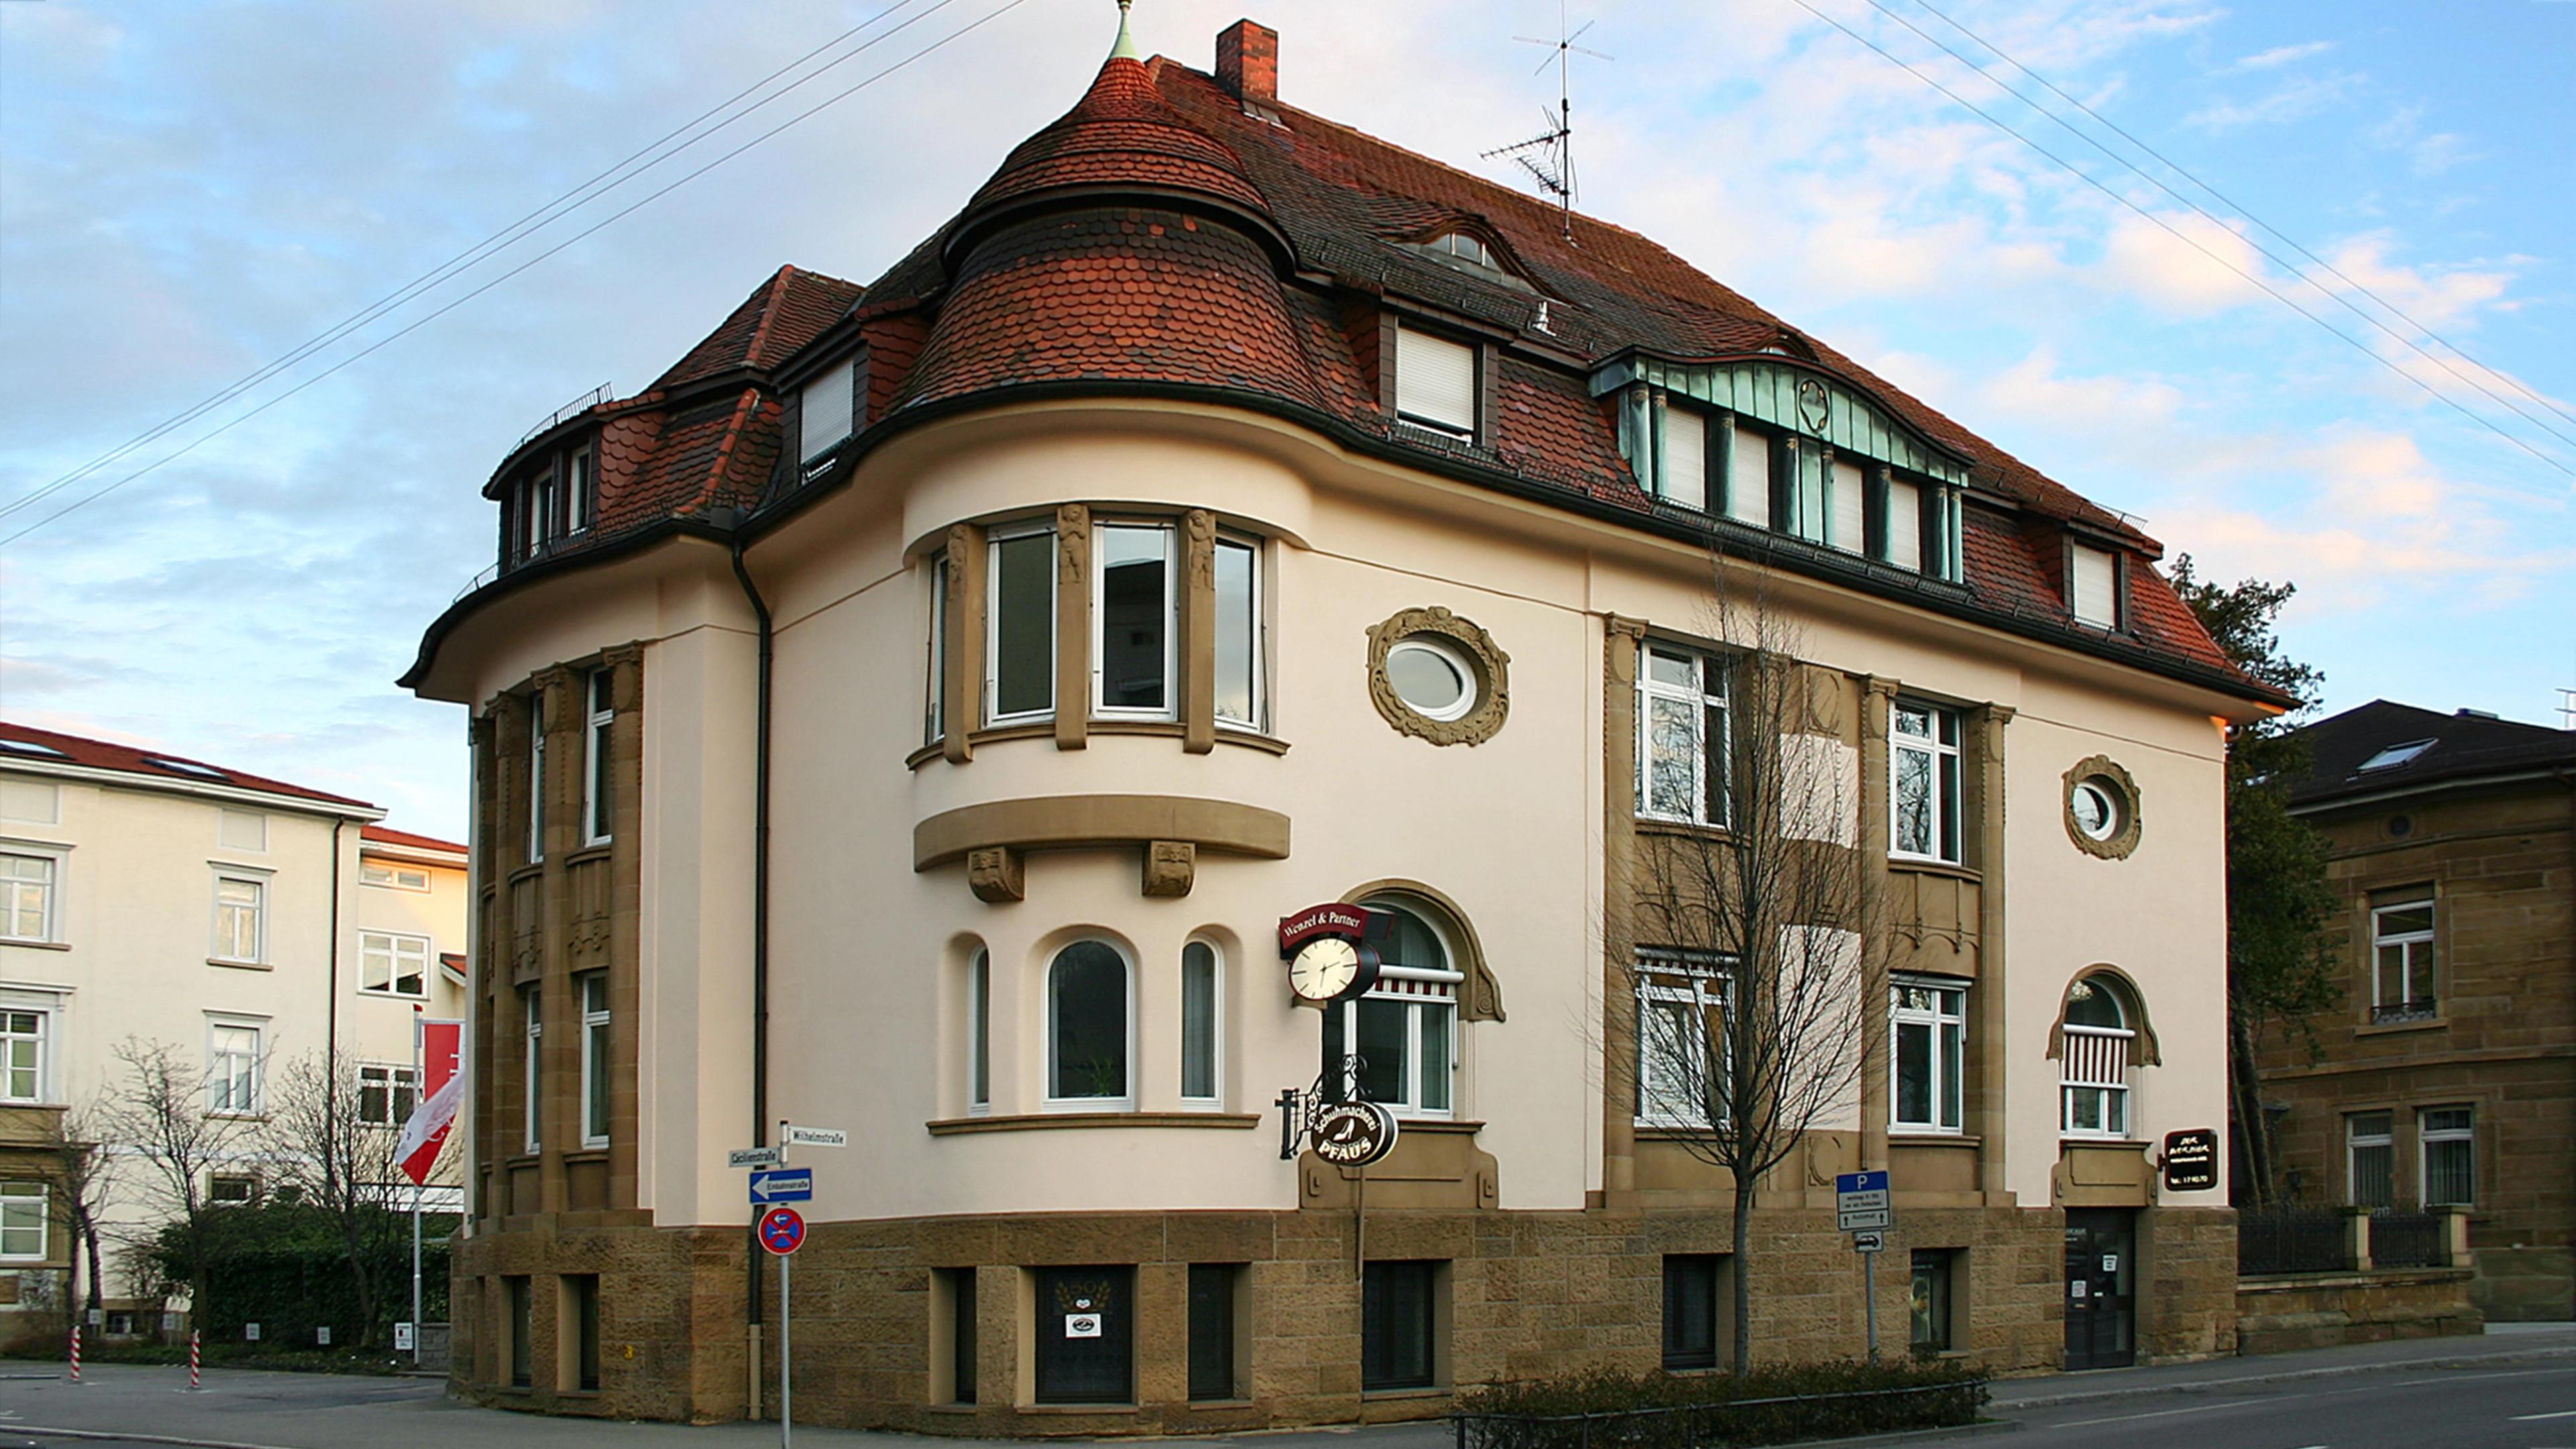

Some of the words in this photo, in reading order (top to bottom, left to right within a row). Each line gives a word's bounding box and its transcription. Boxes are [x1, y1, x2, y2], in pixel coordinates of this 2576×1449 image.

[1284, 914, 1316, 937] Wenzel
[1318, 912, 1328, 925] &
[1329, 911, 1360, 928] Partner
[1314, 1105, 1381, 1134] Schuhmacherei
[794, 1131, 844, 1144] Wilhelmstraße
[767, 1181, 808, 1191] Einbahnstraße
[1857, 1175, 1868, 1190] P
